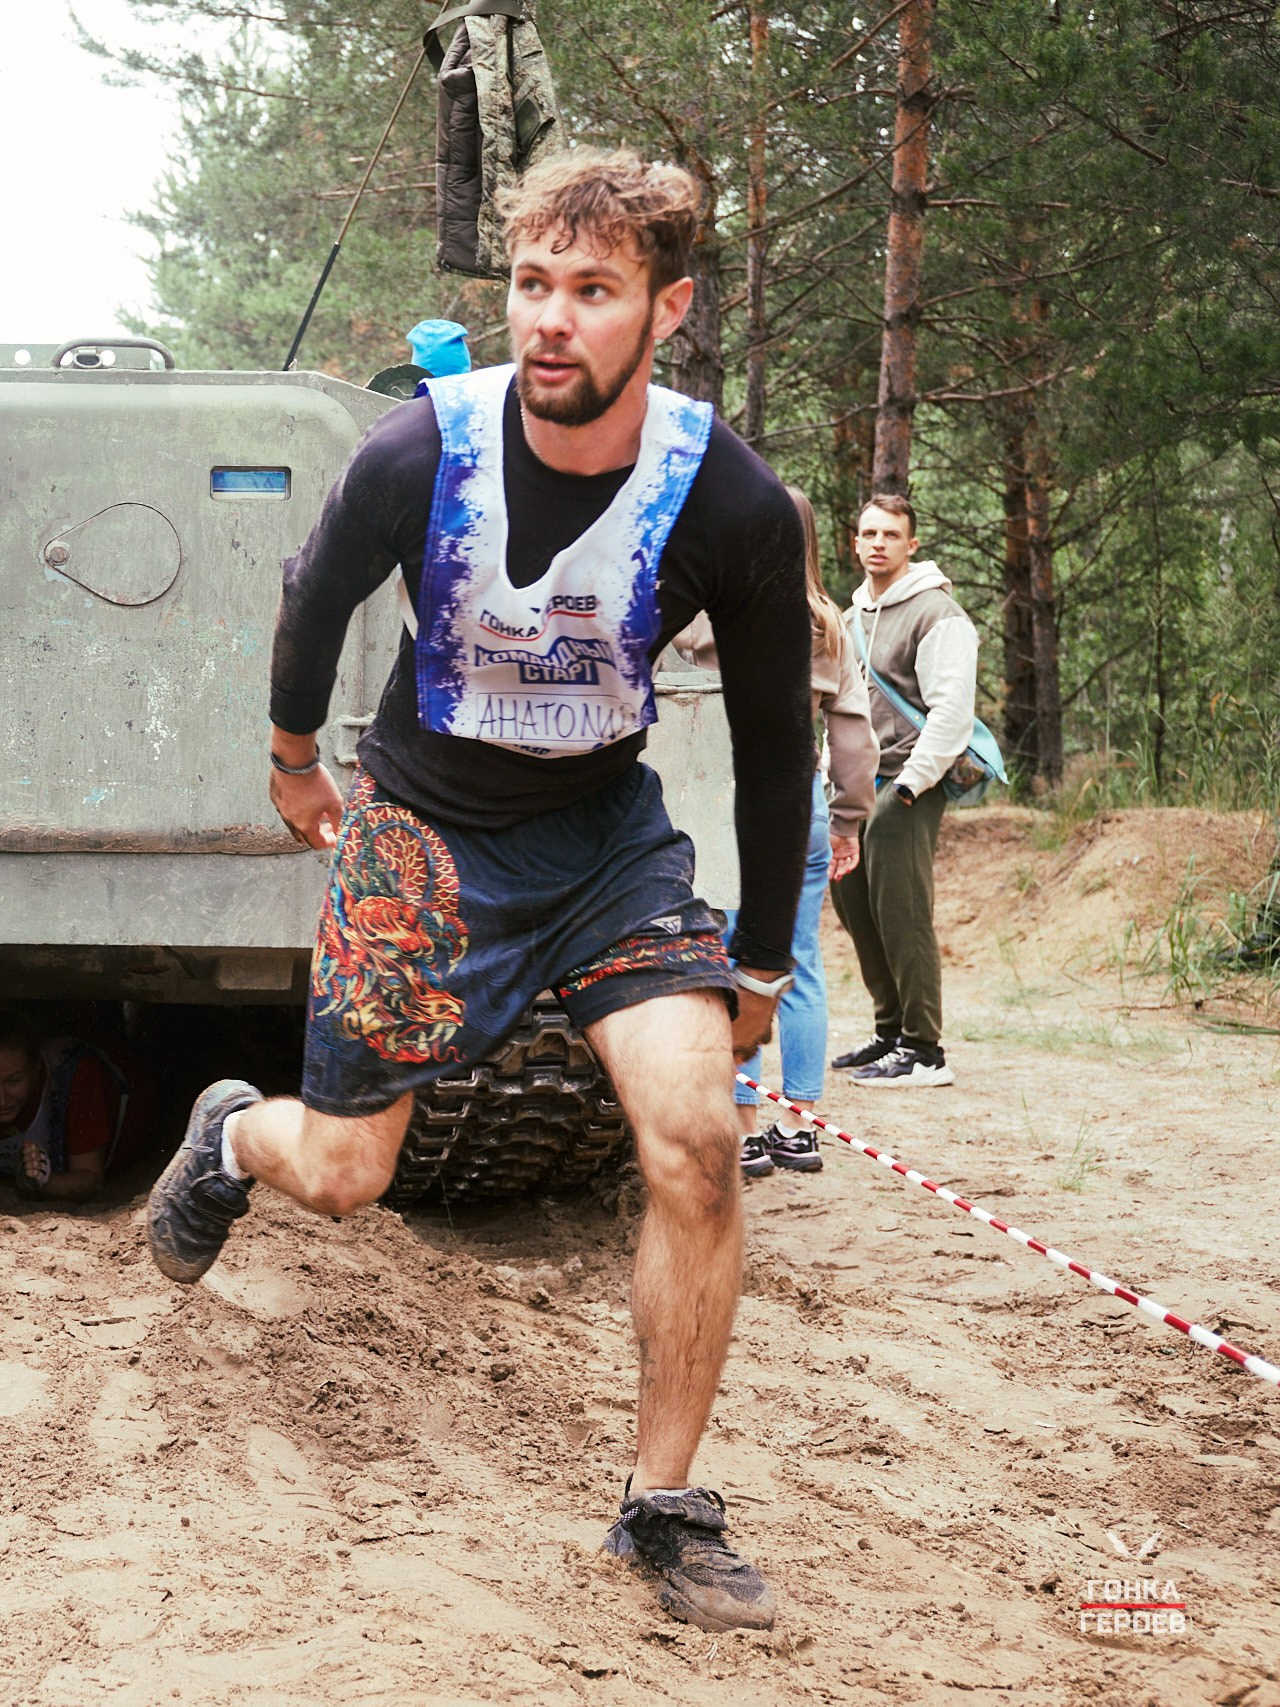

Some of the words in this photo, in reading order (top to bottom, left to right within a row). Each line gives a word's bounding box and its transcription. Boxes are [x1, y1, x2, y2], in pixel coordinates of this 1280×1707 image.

[480, 609, 539, 638] ГОНКА
[544, 595, 597, 615] ЕРОЕВ
[524, 659, 593, 682] СТАРТ
